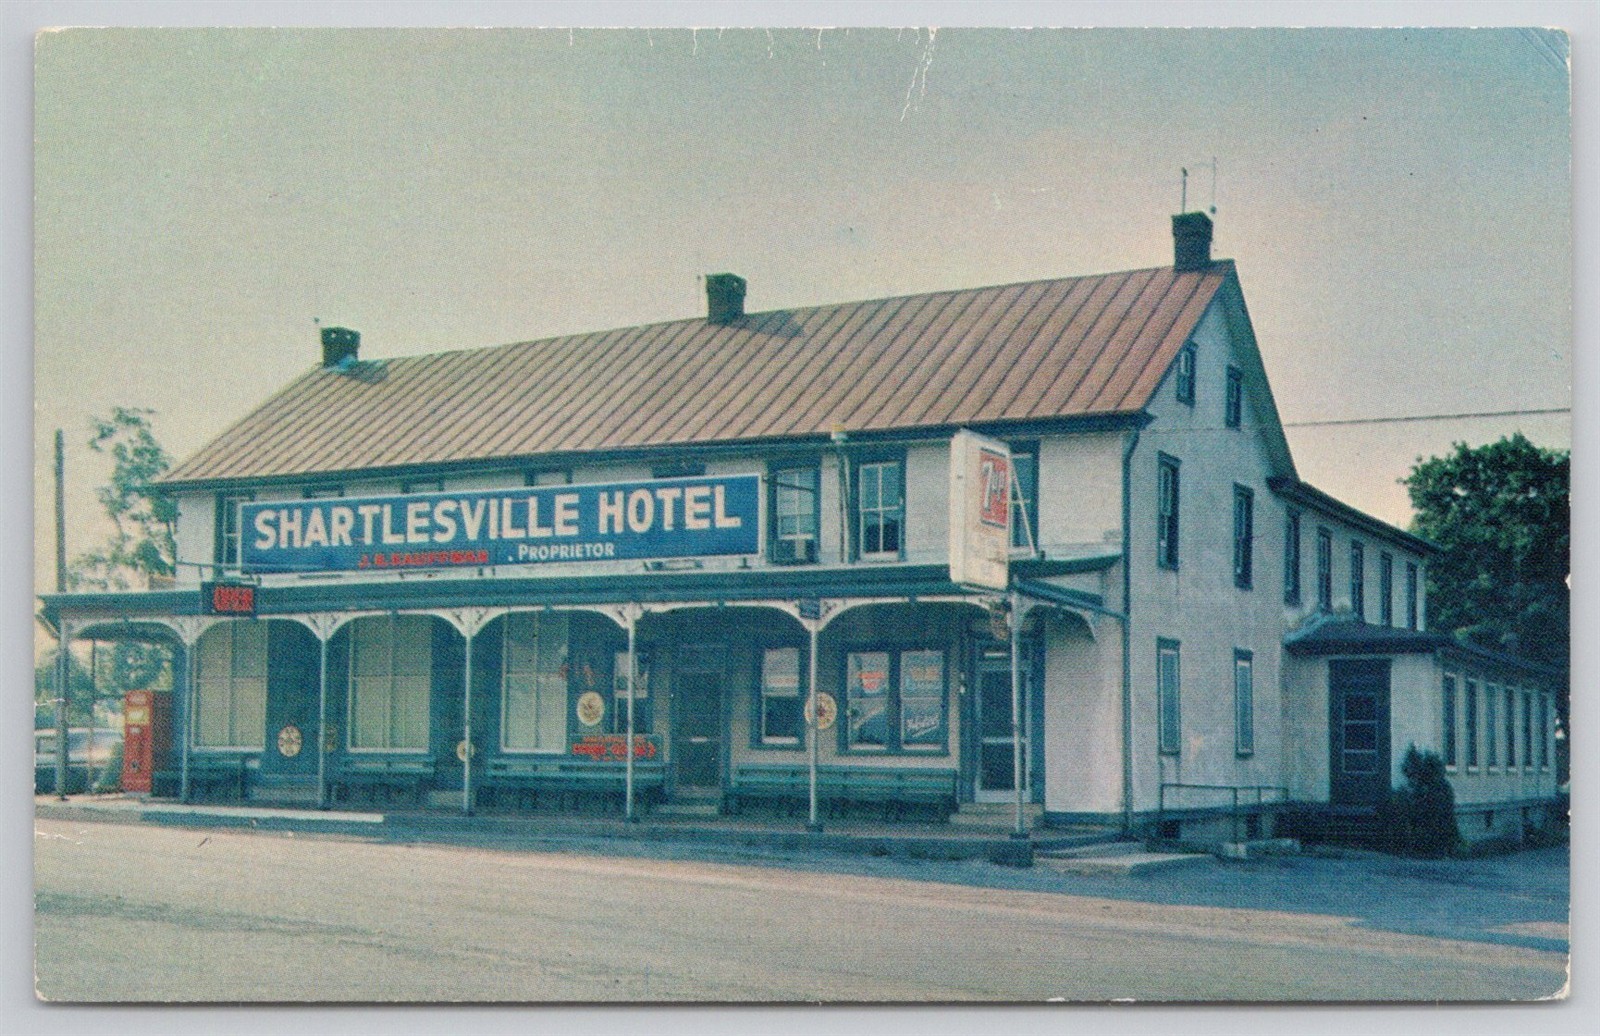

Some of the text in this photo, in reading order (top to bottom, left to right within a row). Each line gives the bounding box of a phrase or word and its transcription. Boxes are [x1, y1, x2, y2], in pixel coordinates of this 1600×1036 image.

[254, 485, 742, 550] SHARTLESVILLE HOTEL
[518, 542, 615, 561] PROPRIETOR
